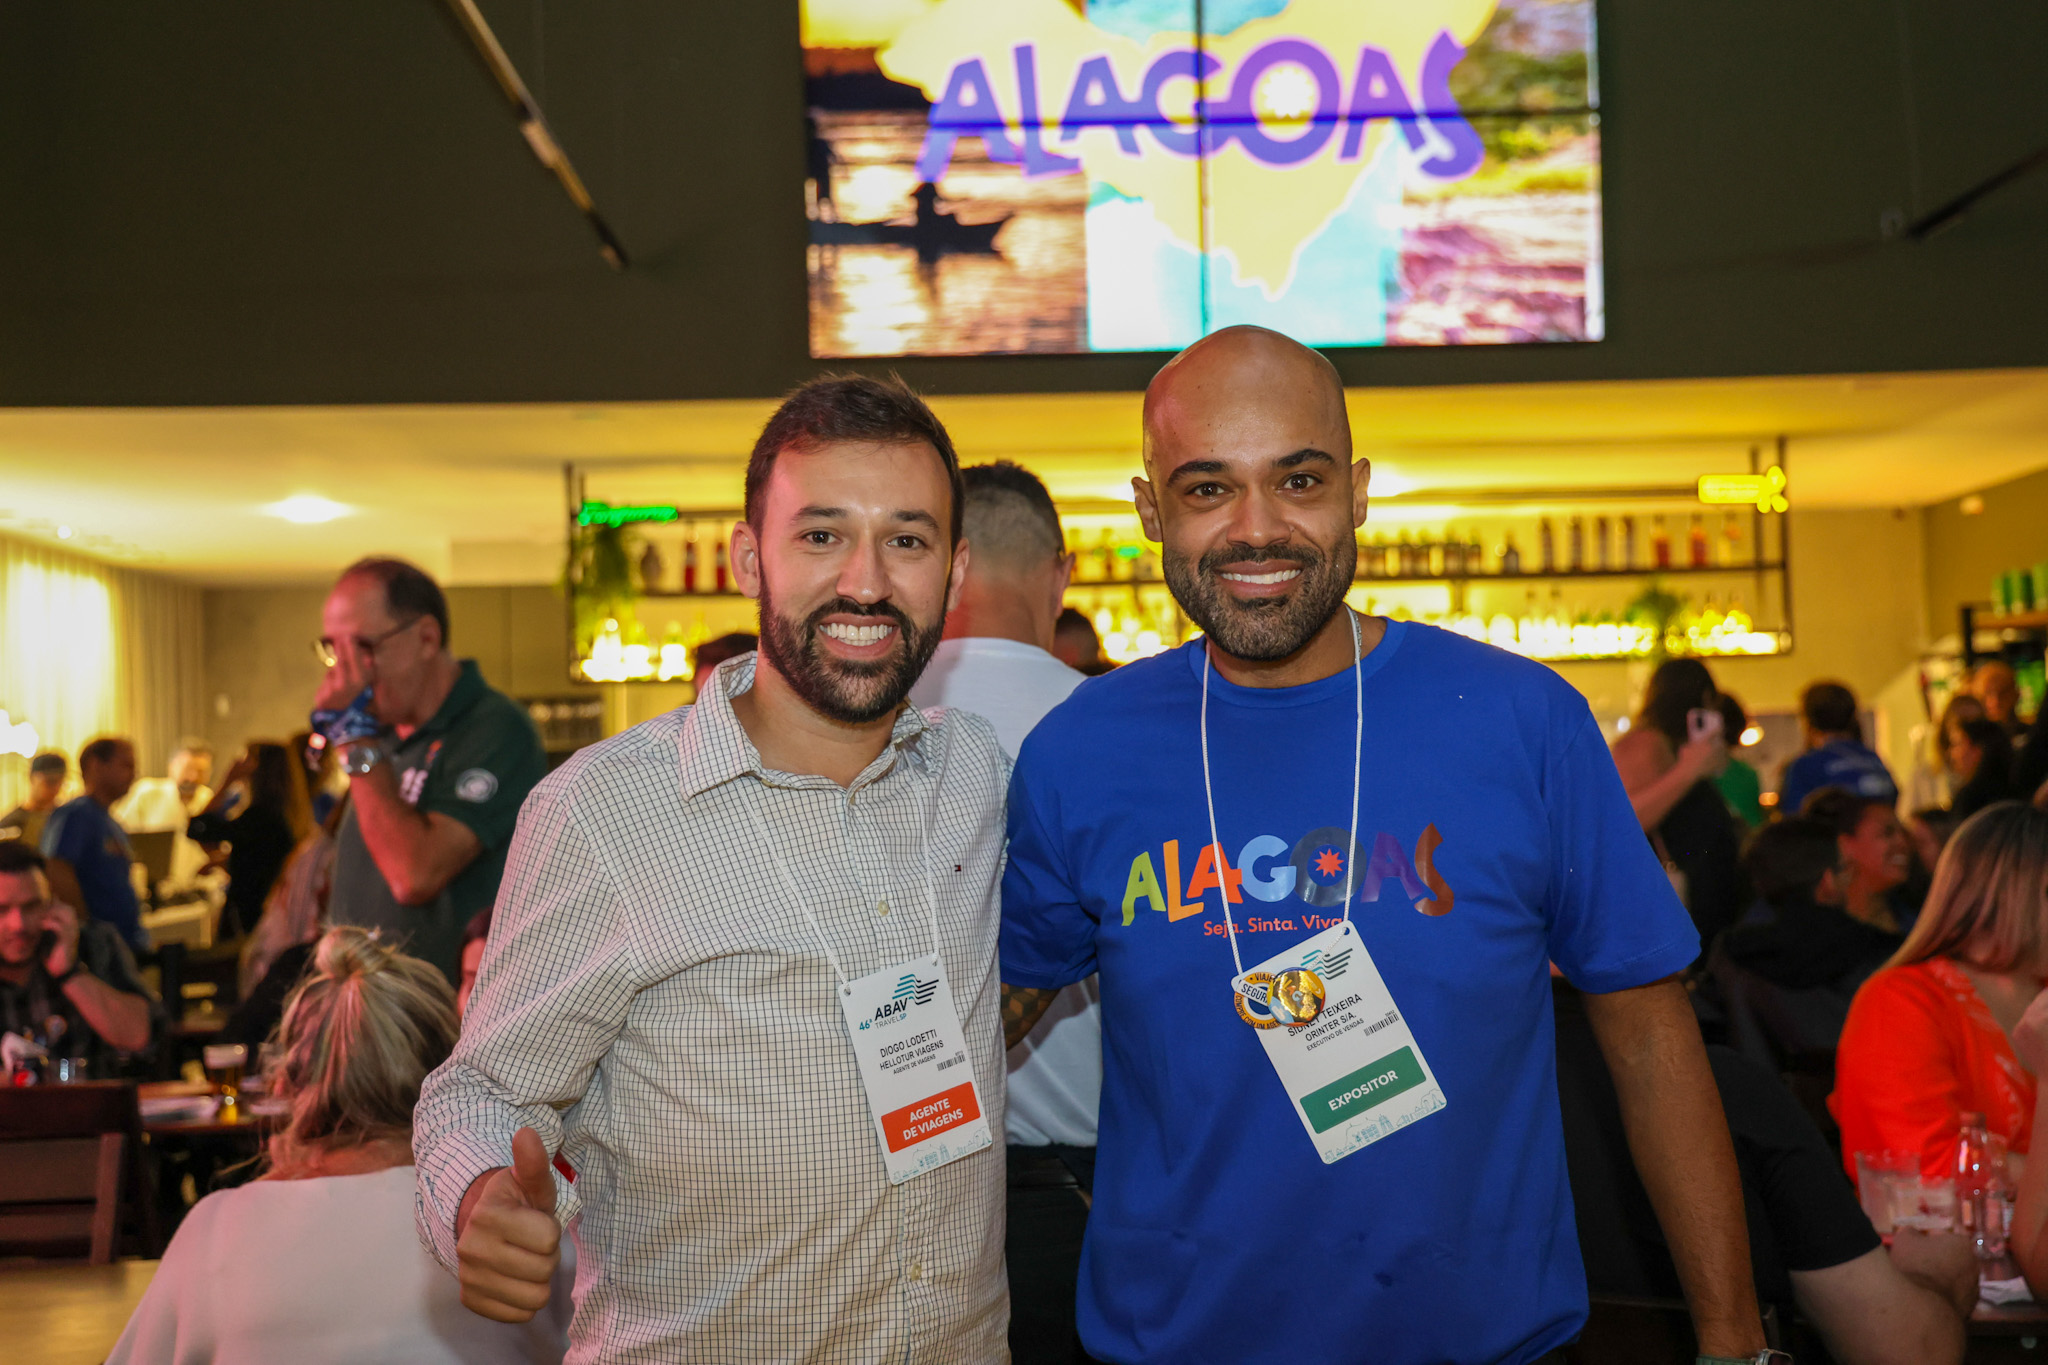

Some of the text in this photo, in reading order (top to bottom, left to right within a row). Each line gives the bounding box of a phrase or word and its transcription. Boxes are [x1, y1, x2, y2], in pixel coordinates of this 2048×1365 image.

[914, 29, 1486, 184] ALAGOAS
[1121, 821, 1455, 926] ALAGOAS
[1247, 917, 1298, 933] Sinta.
[1240, 983, 1268, 1004] SEGUR
[1321, 993, 1363, 1020] TEIXEIRA
[874, 997, 908, 1021] ABAV
[1305, 1011, 1357, 1041] ORINTER S/A.
[1306, 1017, 1365, 1051] EXECUTIVO DE VENDAS
[880, 1028, 938, 1058] DIOGO LODETTI
[880, 1039, 944, 1071] HELLOTUR VIAGENS
[893, 1064, 911, 1075] AGENTE
[917, 1053, 936, 1066] VIAGENS
[1328, 1069, 1399, 1112] EXPOSITOR
[902, 1108, 964, 1141] DE VIAGENS
[909, 1098, 951, 1123] AGENTE
